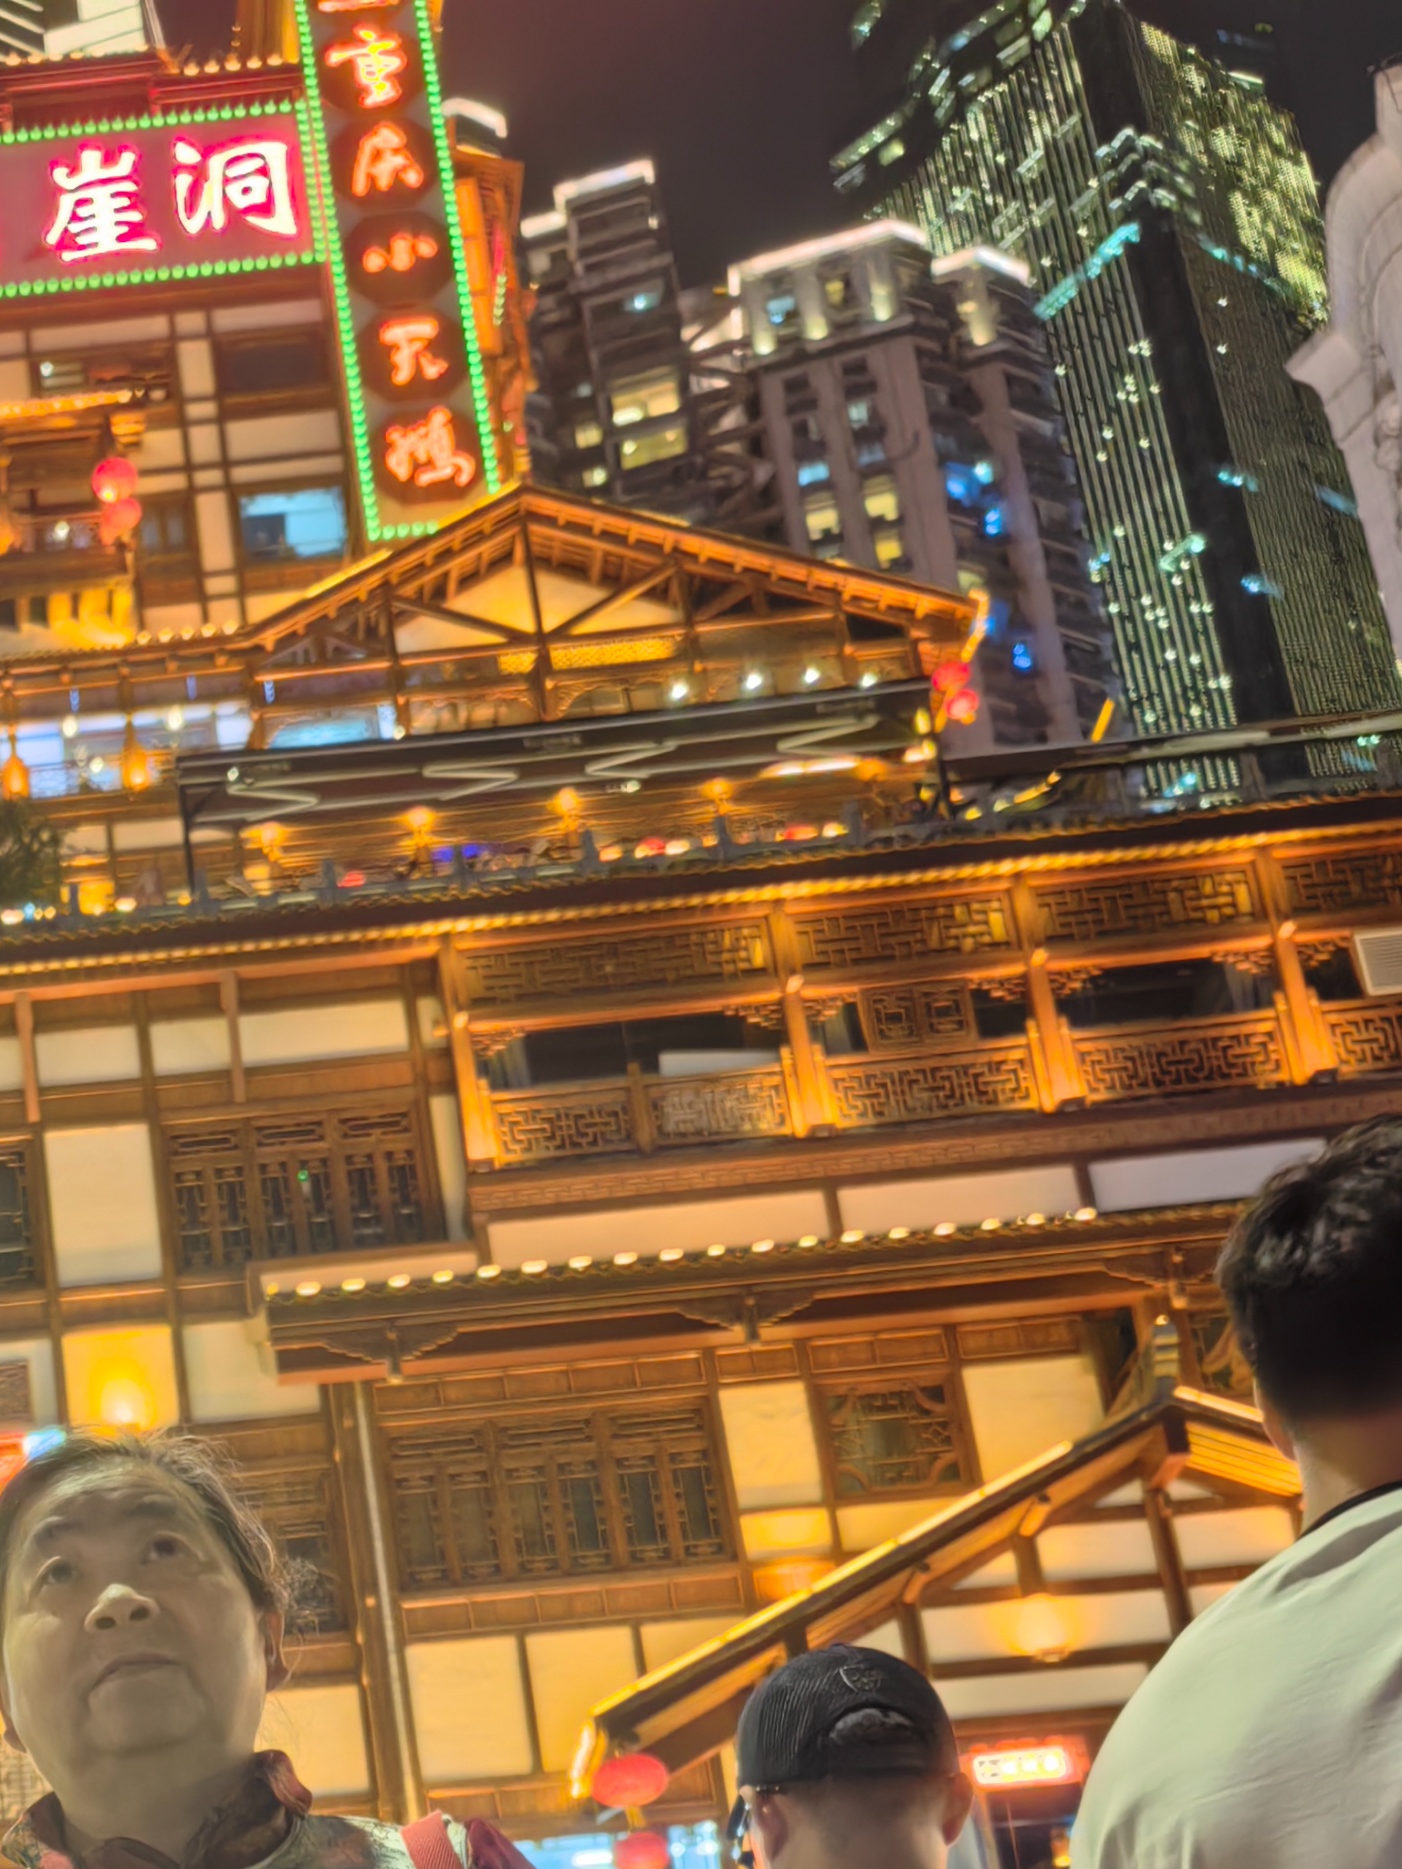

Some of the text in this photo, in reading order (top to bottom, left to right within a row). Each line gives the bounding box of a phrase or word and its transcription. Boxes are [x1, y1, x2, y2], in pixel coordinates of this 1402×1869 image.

[318, 0, 476, 487] 重庆小天鹅
